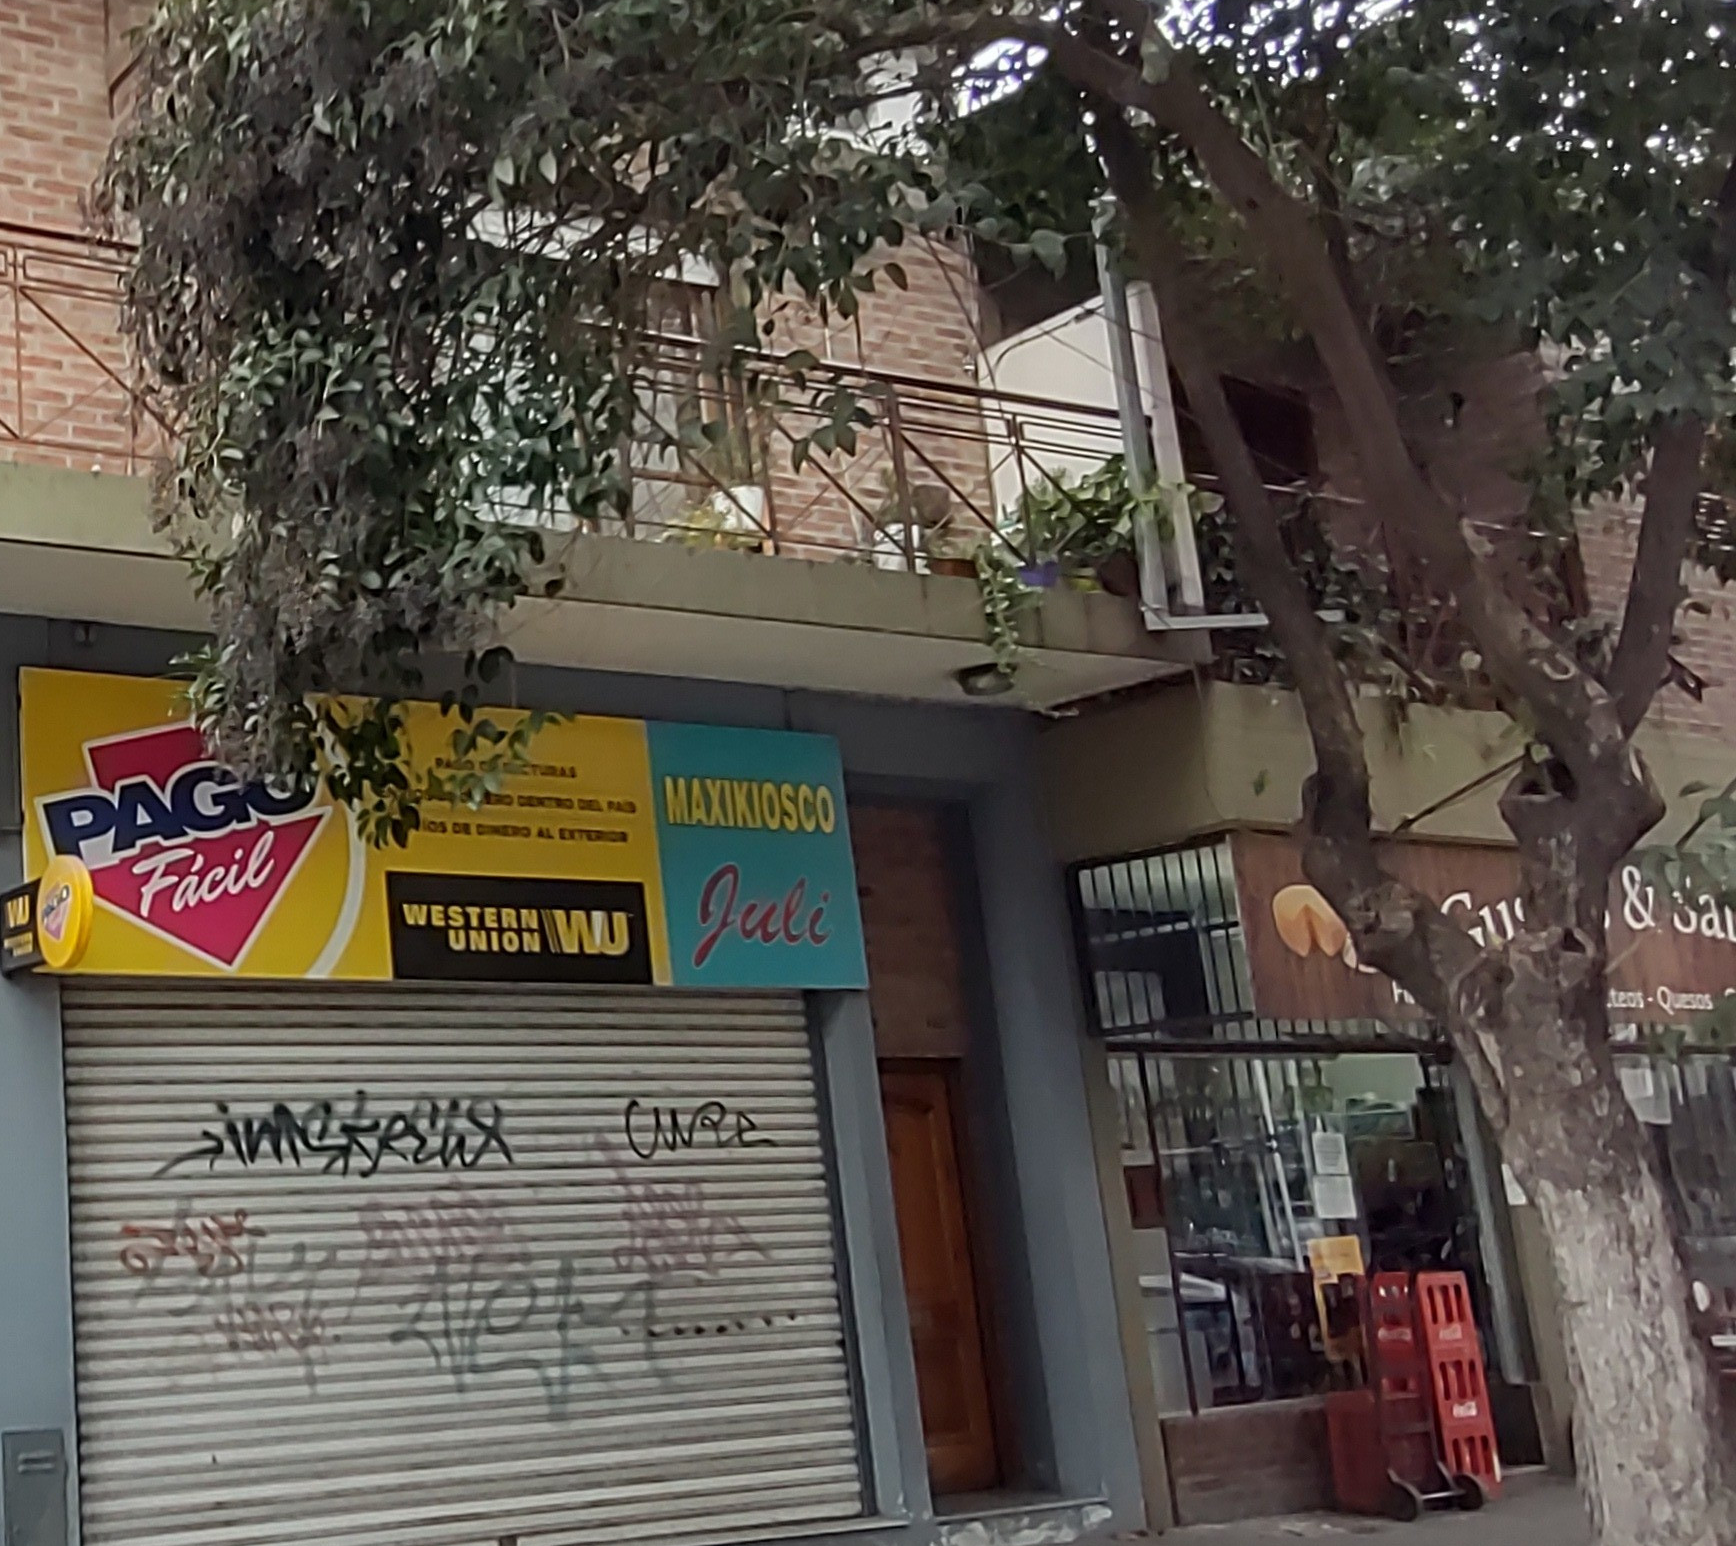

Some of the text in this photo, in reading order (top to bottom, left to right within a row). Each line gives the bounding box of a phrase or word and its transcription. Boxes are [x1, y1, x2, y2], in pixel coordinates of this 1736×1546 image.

[517, 794, 575, 810] DENTRO
[577, 797, 604, 812] DEL
[664, 774, 836, 835] MAXIKIOSCO
[452, 822, 472, 836] DE
[476, 823, 531, 838] DINERO
[537, 826, 555, 839] AL
[558, 827, 629, 843] EXTERIOR
[131, 830, 275, 918] Fácil
[402, 903, 539, 930] WESTERN
[552, 908, 630, 955] WU
[692, 861, 832, 969] Juli
[448, 929, 541, 953] UNION
